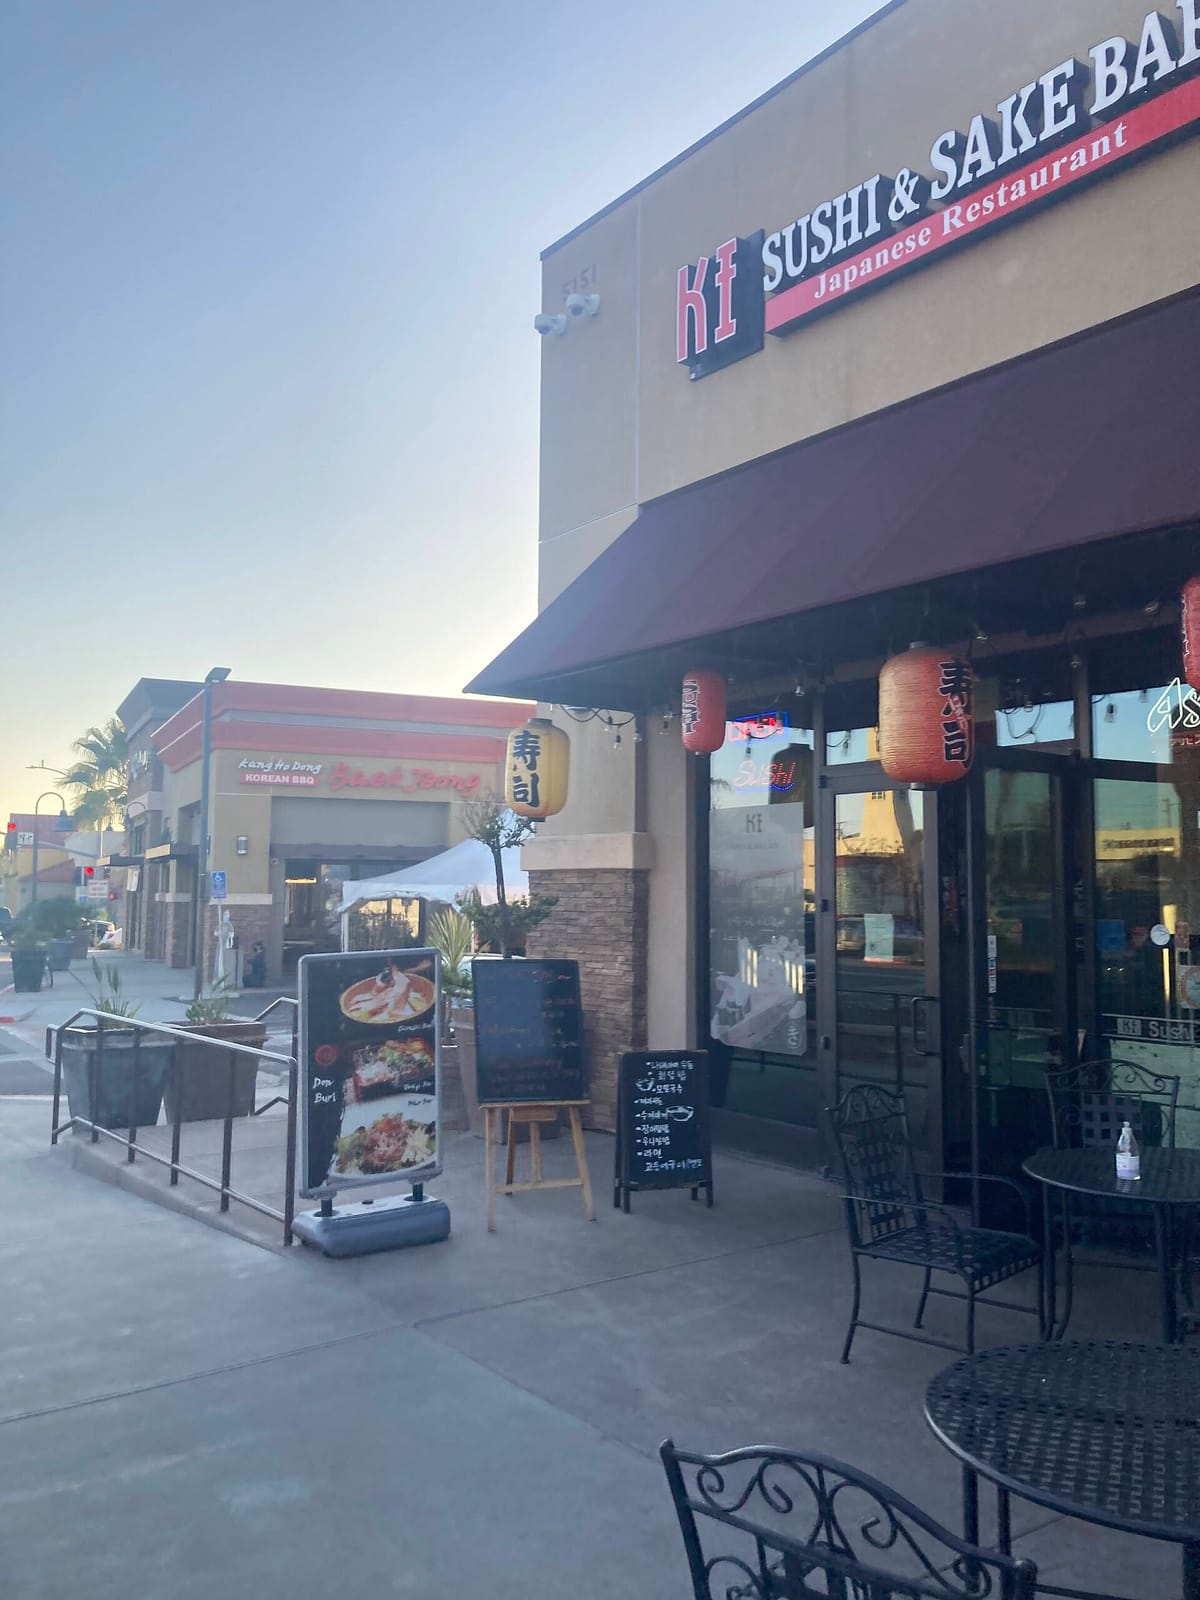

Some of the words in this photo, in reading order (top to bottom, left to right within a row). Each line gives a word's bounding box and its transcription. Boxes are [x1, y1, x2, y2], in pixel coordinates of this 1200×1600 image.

[762, 174, 881, 291] SUSHI
[888, 167, 920, 221] &
[930, 57, 1076, 200] SAKE
[814, 226, 932, 299] Japanese
[942, 121, 1127, 236] Restaurant
[727, 716, 785, 743] OPEN
[245, 774, 290, 784] KOREAN
[292, 775, 315, 785] BBQ
[275, 760, 290, 770] Ho
[292, 761, 322, 774] Dong
[512, 729, 541, 807] 寿司
[314, 1092, 336, 1104] Buri
